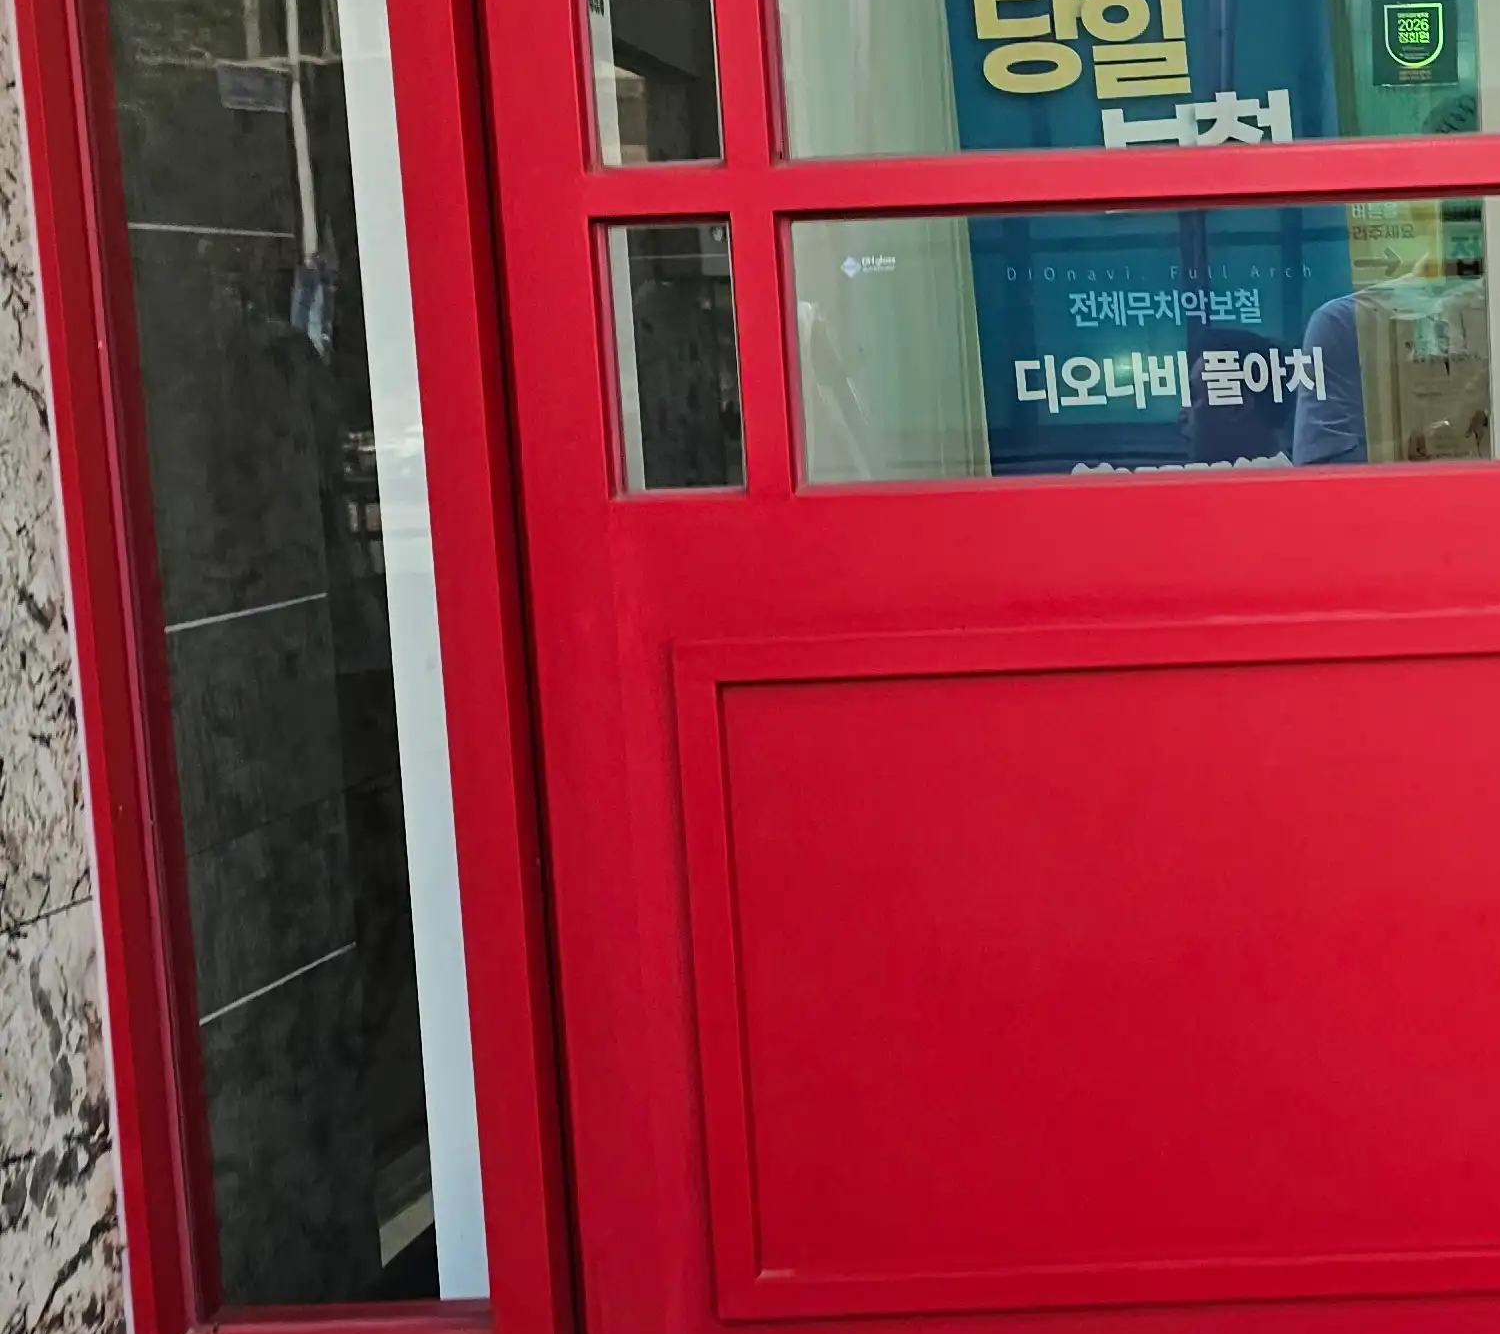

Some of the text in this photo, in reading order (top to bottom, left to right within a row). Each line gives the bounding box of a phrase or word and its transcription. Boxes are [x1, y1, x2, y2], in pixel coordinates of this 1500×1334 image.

[1398, 19, 1430, 31] 2026
[1351, 224, 1415, 241] 러주세요
[1170, 266, 1228, 280] Full
[1250, 265, 1313, 279] Arch
[1069, 288, 1262, 327] 전체무치악보철
[1014, 347, 1327, 414] 디오나비 풀아치
